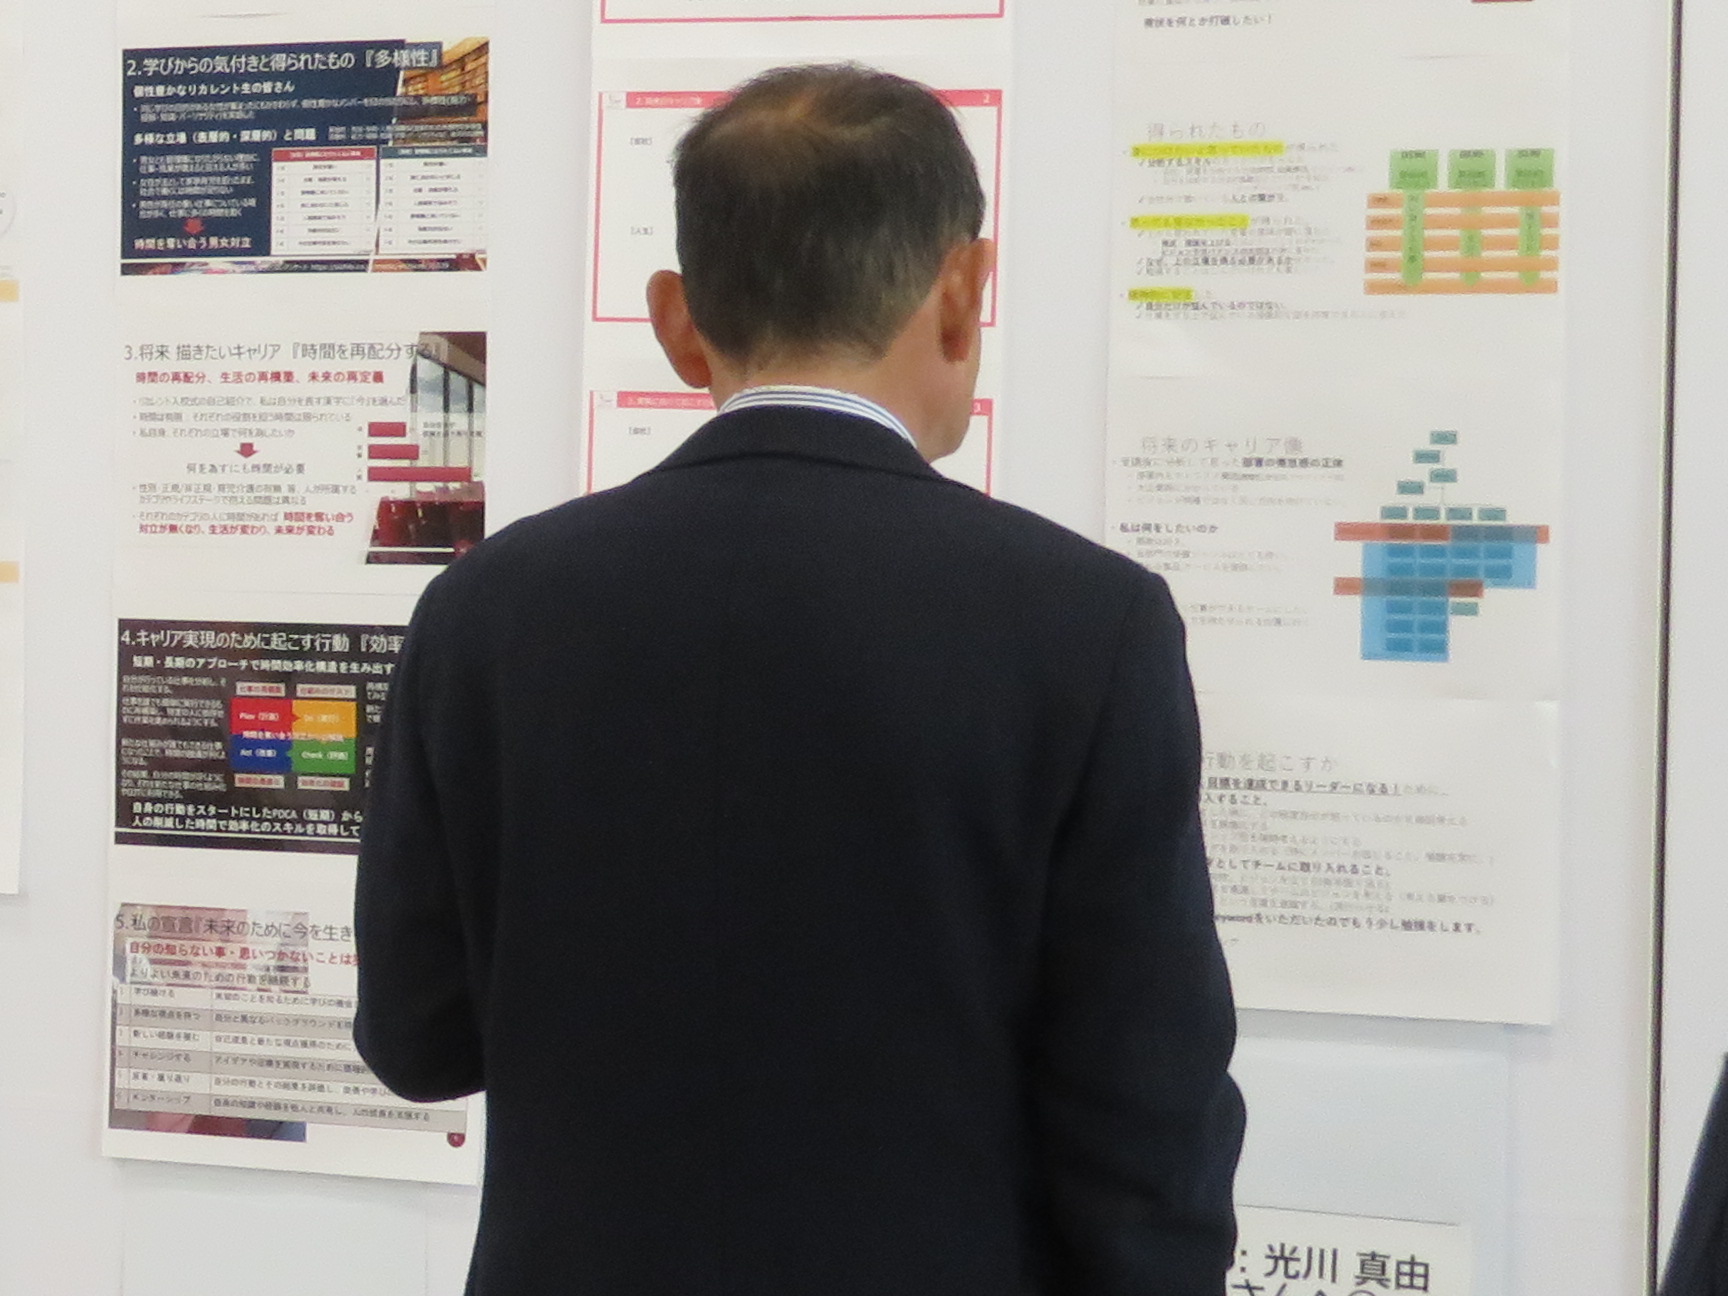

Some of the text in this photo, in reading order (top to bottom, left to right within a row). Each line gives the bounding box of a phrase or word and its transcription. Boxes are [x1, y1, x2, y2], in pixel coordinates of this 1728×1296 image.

[133, 80, 295, 98] 個性豊かなリカレント生の皆さん
[1146, 121, 1267, 140] 得られたもの
[135, 370, 385, 385] 時間の再配分、生活の再構築、未来の再定義
[1141, 437, 1303, 456] 将来のキャリア像
[186, 463, 306, 475] 何を為すにも時間が必要
[139, 524, 335, 536] 対立が無くなり、生活が変わり、未来が変わる
[1119, 521, 1219, 535] 私は何をしたいのか
[1264, 1242, 1339, 1284] 光川
[1354, 1250, 1431, 1293] 真由
